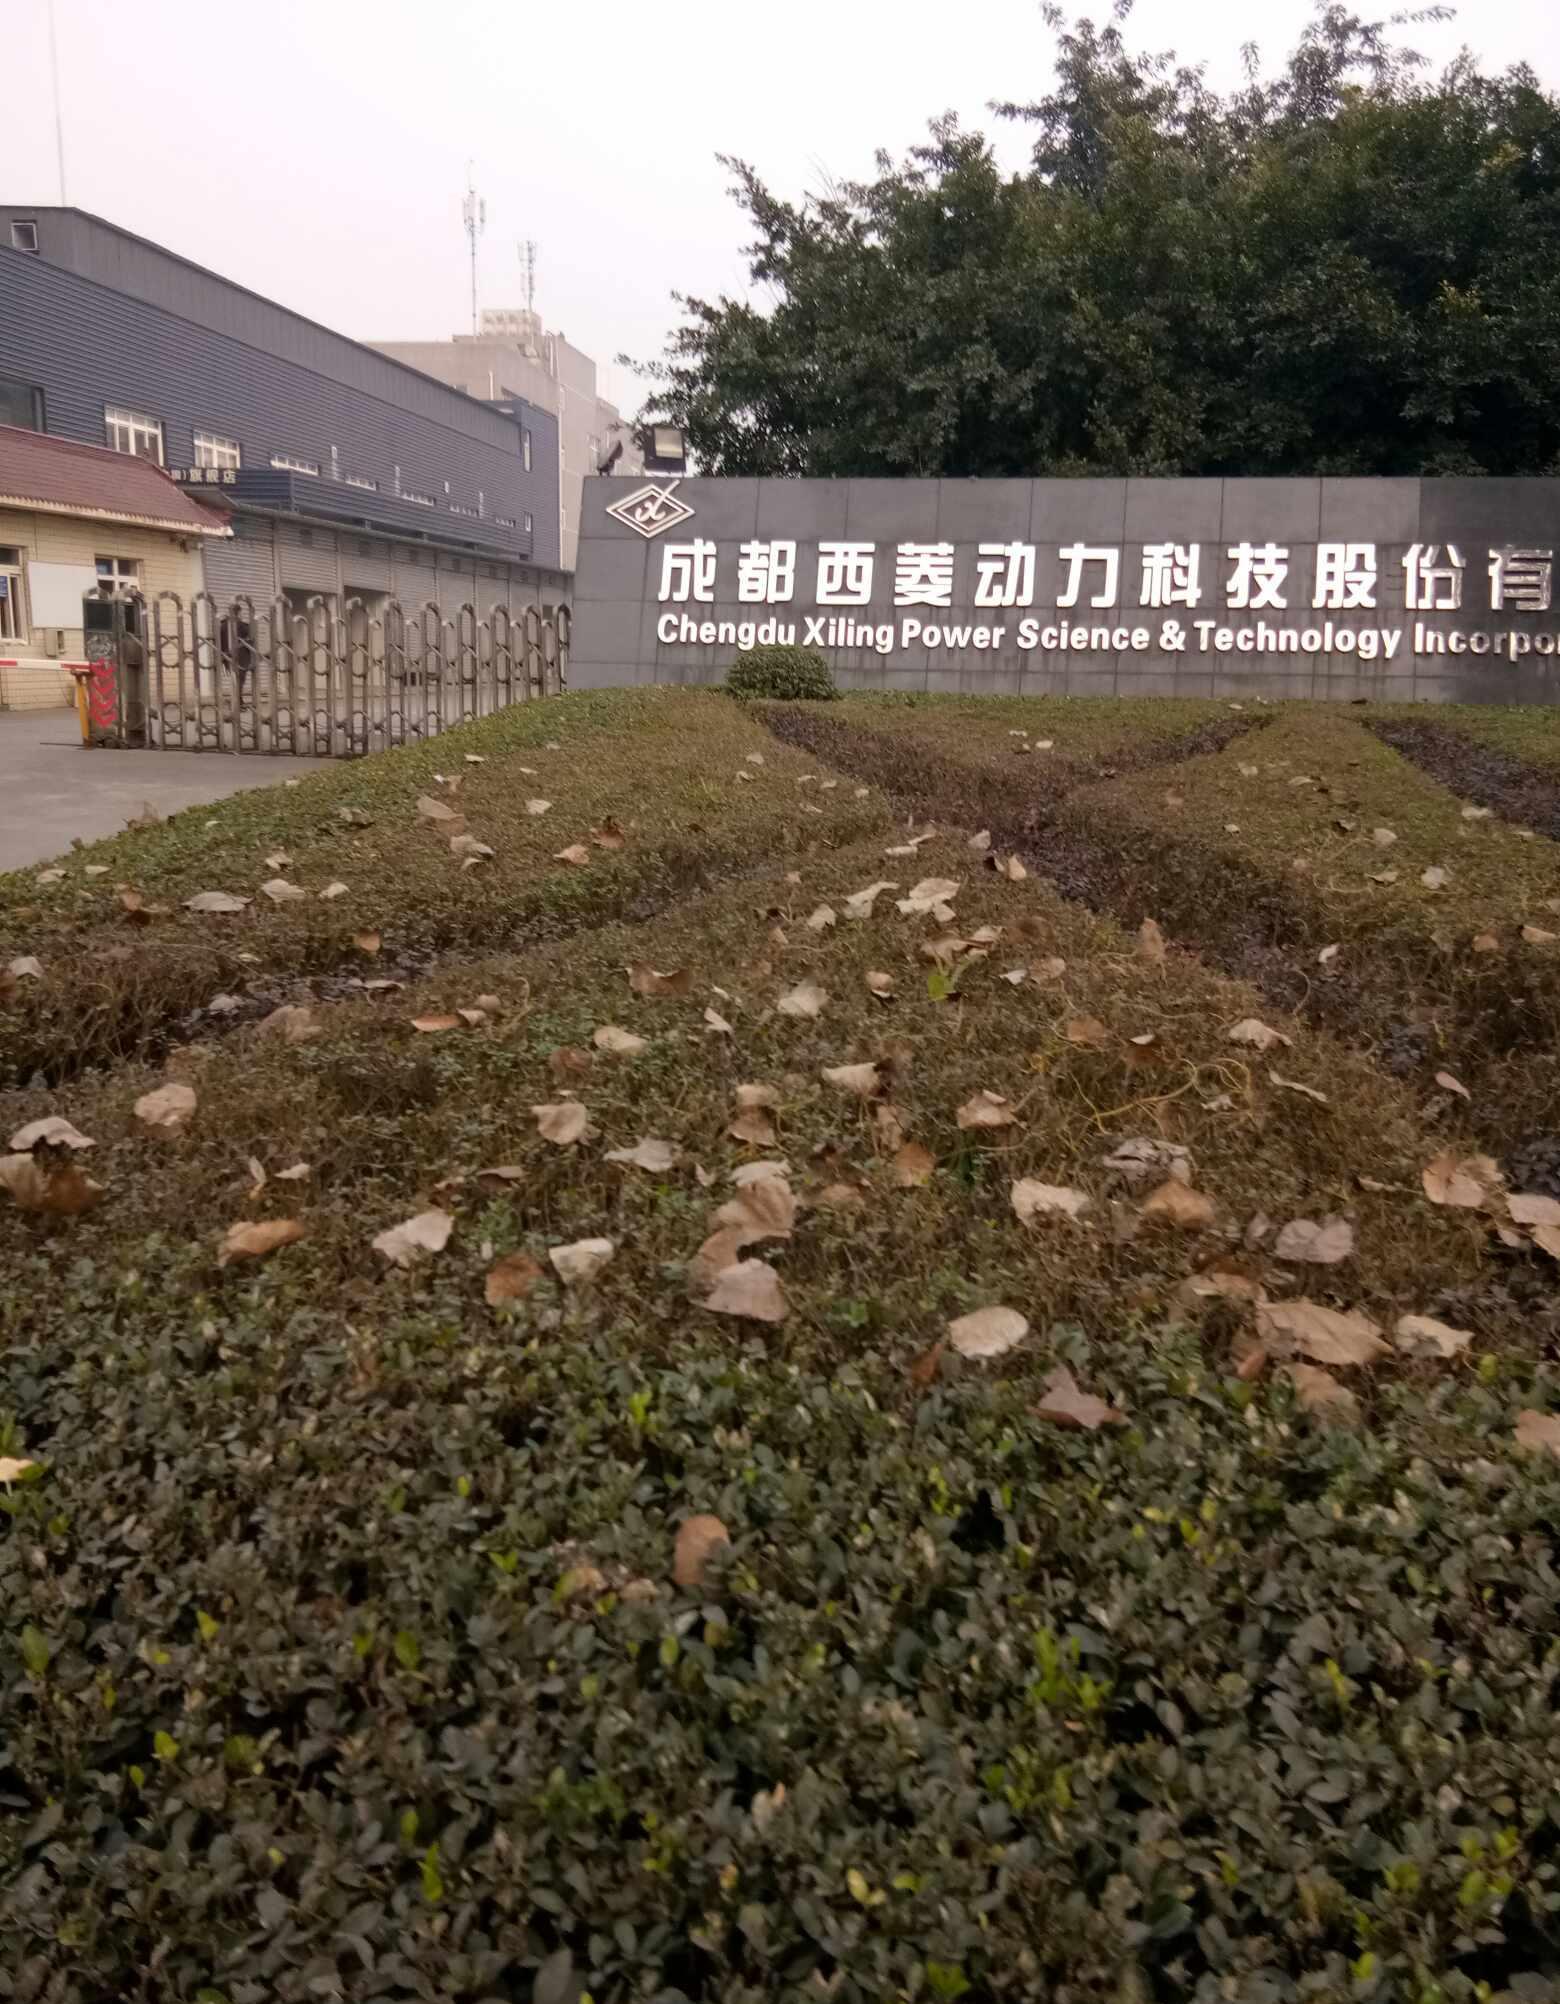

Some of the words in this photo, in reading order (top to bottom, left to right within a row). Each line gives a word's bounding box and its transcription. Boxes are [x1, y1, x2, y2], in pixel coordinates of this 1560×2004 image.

[658, 538, 1552, 611] 成都西菱动力科技股份有
[657, 613, 796, 651] Chengdu
[802, 617, 895, 655] Xiling
[901, 619, 1005, 649] Power
[1017, 619, 1151, 651] Science
[1160, 620, 1186, 652] &
[1193, 620, 1401, 660] Technology
[1414, 622, 1560, 662] Incorpo
